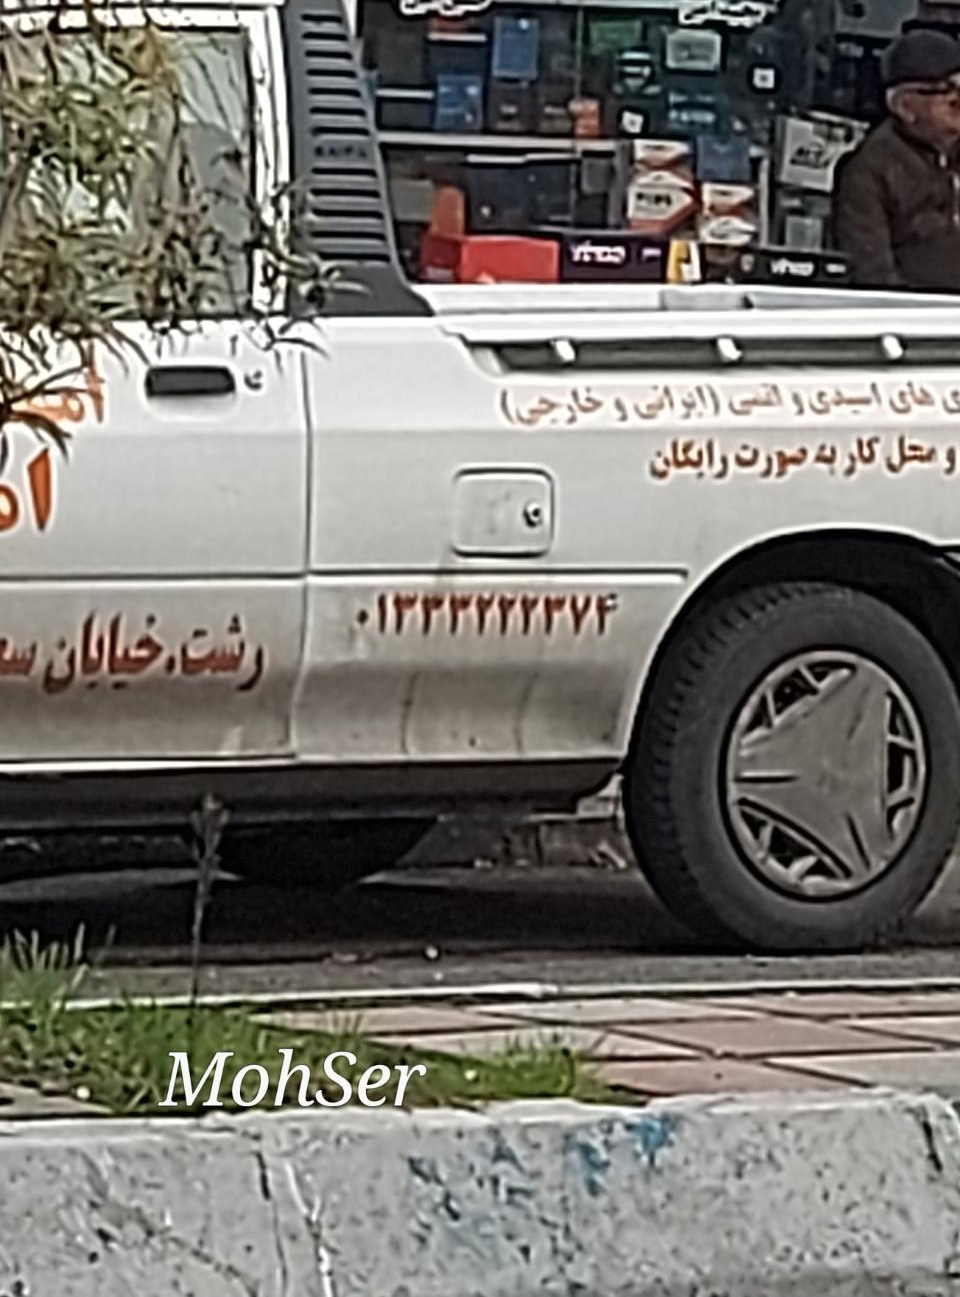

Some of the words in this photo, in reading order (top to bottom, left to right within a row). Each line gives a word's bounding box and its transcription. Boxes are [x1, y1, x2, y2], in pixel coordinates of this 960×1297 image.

[614, 397, 628, 422] و
[792, 392, 803, 416] و
[889, 381, 935, 414] های
[649, 438, 729, 478] رایگان
[735, 442, 809, 478] صورت
[813, 442, 837, 475] به
[843, 437, 879, 477] کار
[886, 435, 937, 474] محل
[944, 445, 956, 475] و
[42, 610, 164, 695] خیابان
